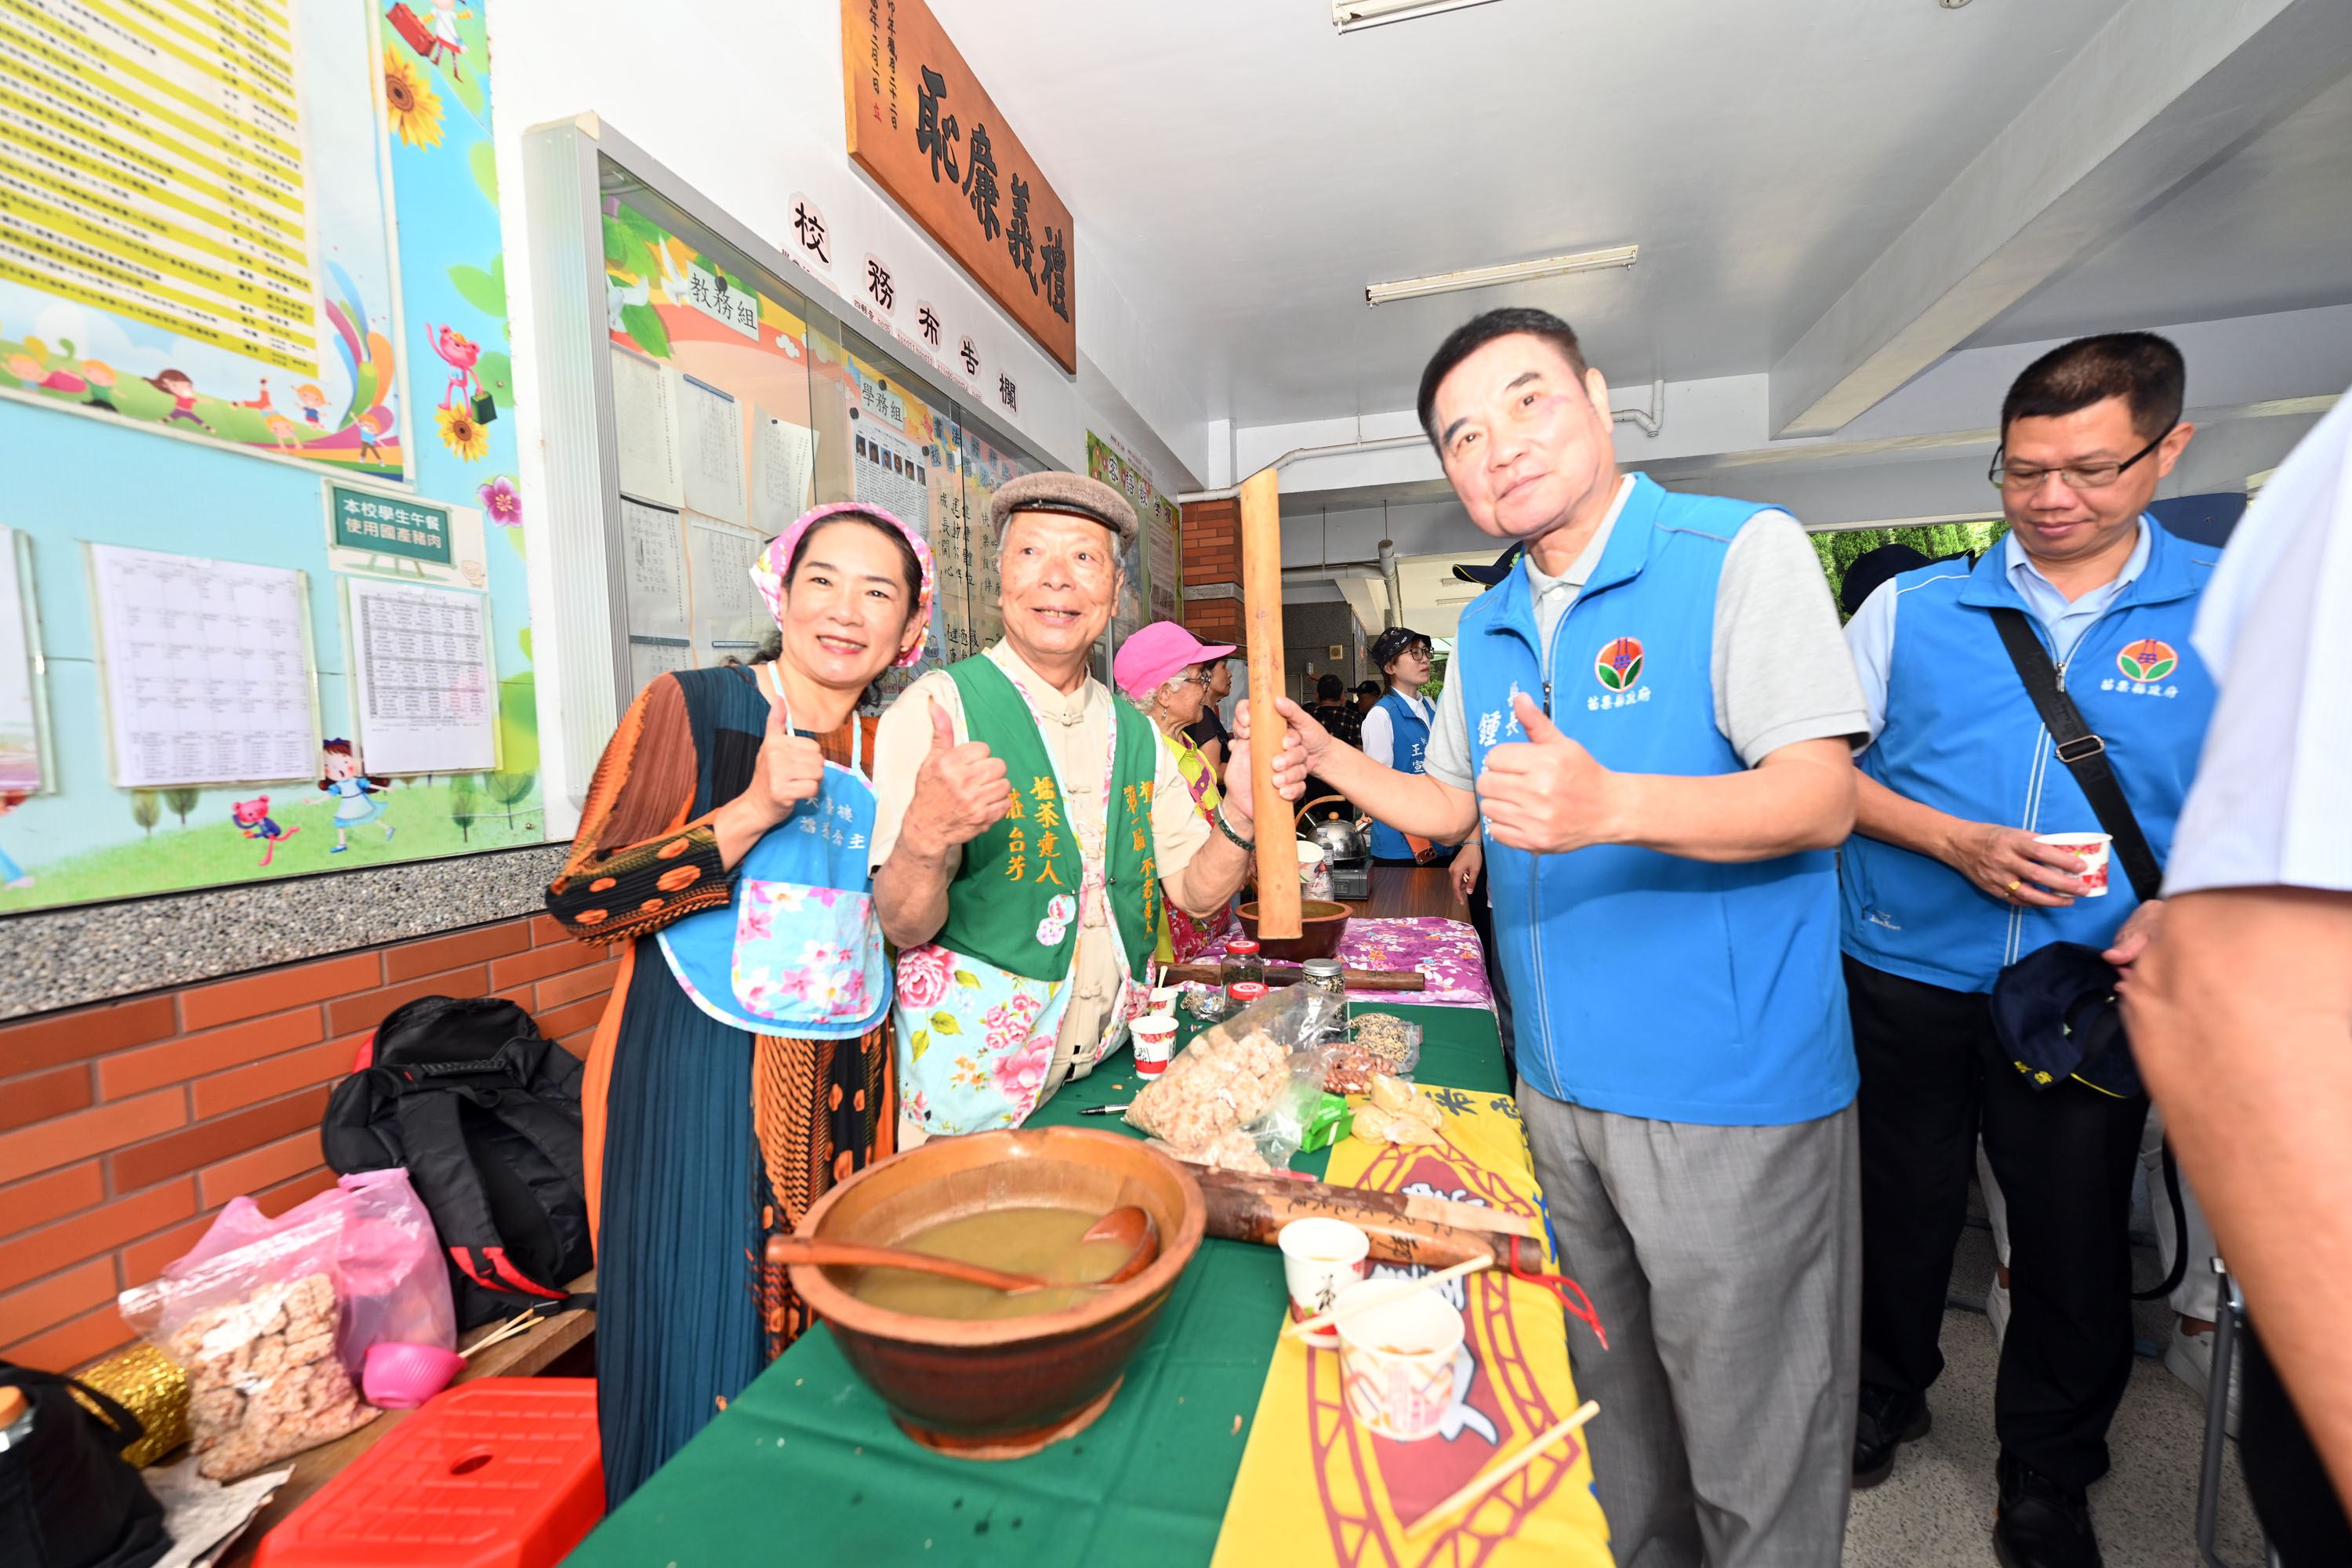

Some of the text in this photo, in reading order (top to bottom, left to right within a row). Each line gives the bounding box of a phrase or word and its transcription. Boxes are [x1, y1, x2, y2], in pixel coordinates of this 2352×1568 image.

[691, 272, 757, 329] 教務組
[794, 202, 1017, 412] 校務布告欄
[862, 383, 903, 423] 學務組
[343, 498, 441, 531] 本校學生午餐
[345, 517, 441, 549] 使用國產豬肉
[1587, 686, 1651, 710] 苗栗縣政府
[2100, 678, 2179, 698] 苗栗縣政府
